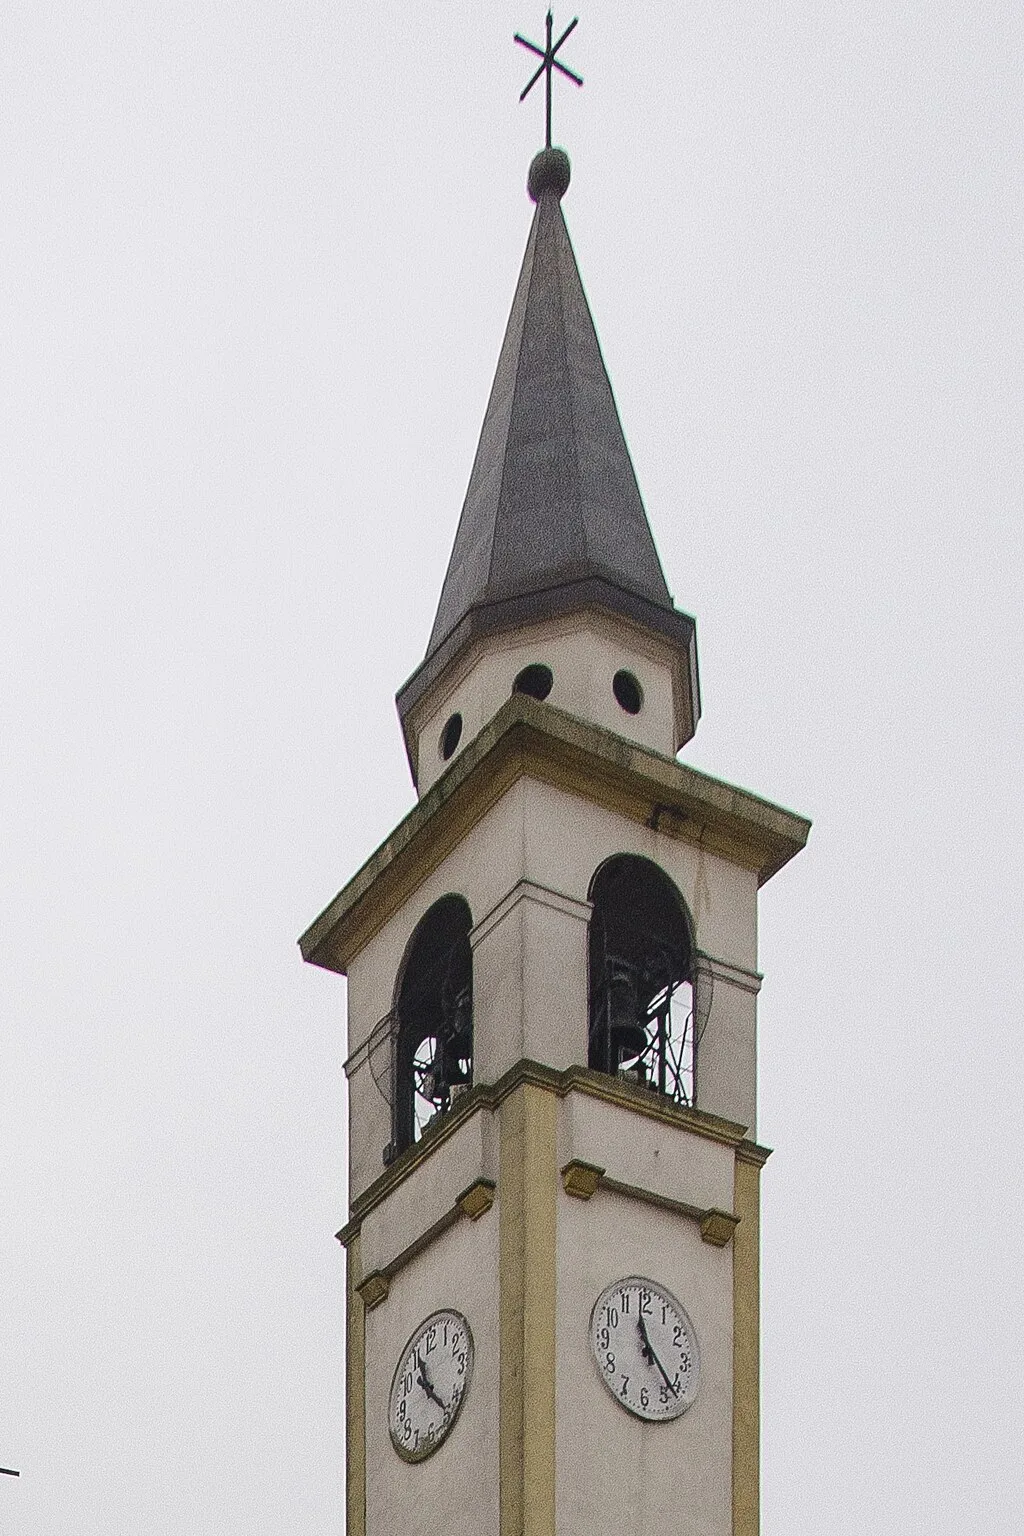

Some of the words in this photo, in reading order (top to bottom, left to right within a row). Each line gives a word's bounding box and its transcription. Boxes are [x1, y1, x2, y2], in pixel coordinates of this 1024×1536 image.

[621, 1294, 629, 1313] 11
[638, 1291, 652, 1315] 12
[607, 1307, 618, 1328] 10
[662, 1306, 666, 1325] 1
[426, 1329, 437, 1355] 12
[443, 1325, 447, 1346] 1
[452, 1333, 460, 1357] 2
[601, 1328, 609, 1349] 9
[672, 1325, 682, 1348] 2
[457, 1352, 465, 1375] 3
[606, 1352, 615, 1373] 8
[679, 1352, 688, 1373] 3
[402, 1372, 413, 1397] 10
[620, 1374, 629, 1396] 7
[672, 1373, 681, 1393] 4
[640, 1387, 649, 1406] 6
[659, 1385, 669, 1404] 5
[400, 1399, 406, 1422] 9
[404, 1418, 412, 1441] 8
[413, 1428, 419, 1448] 7
[428, 1422, 435, 1443] 6
